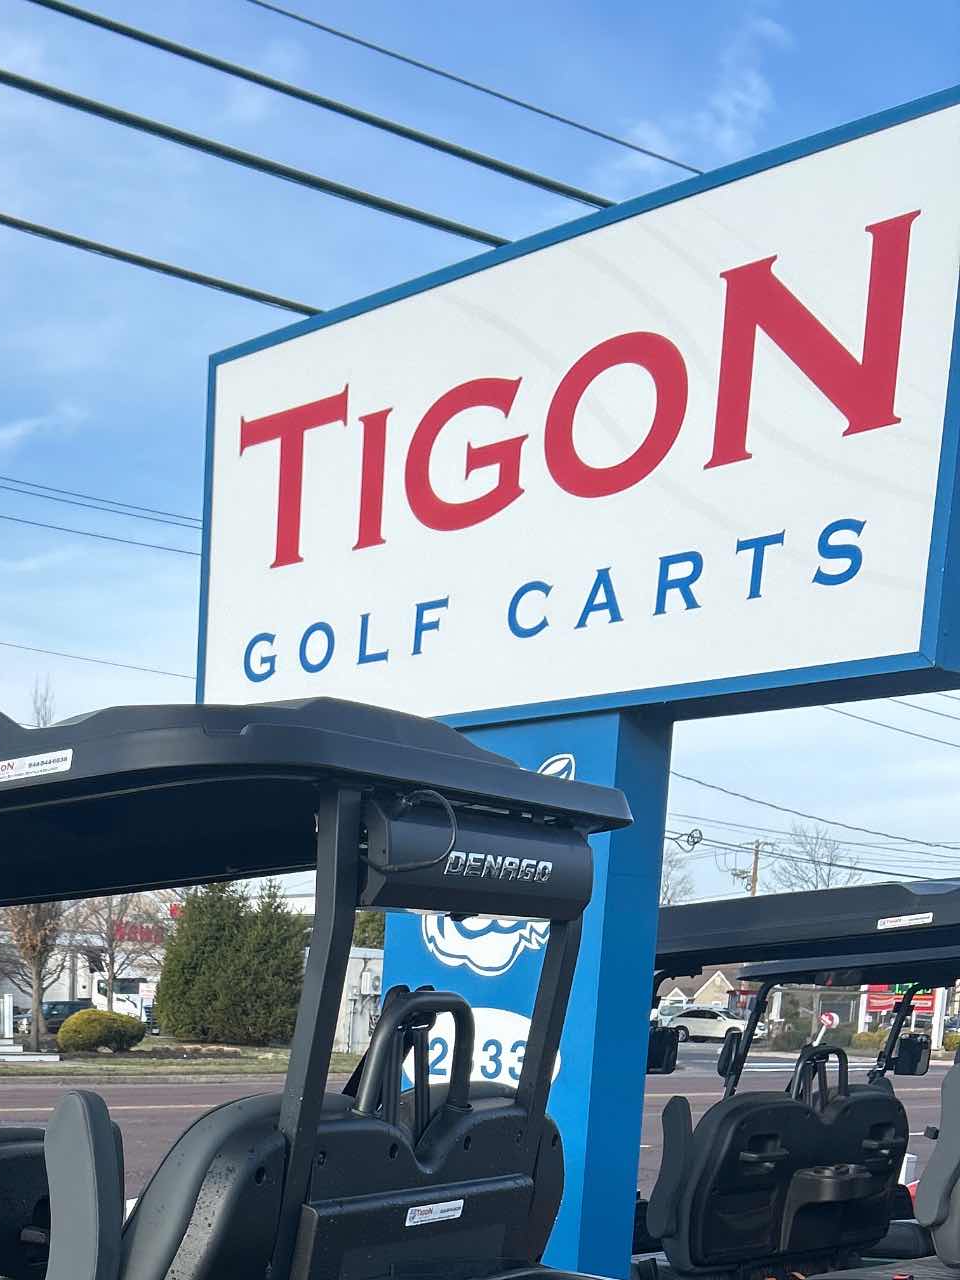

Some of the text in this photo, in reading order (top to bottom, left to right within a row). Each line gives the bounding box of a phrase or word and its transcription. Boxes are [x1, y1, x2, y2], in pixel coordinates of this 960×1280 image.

[240, 209, 922, 569] TIGON
[243, 519, 867, 683] GOLF CARTS
[443, 851, 553, 882] DENAGO
[429, 1037, 528, 1080] 233
